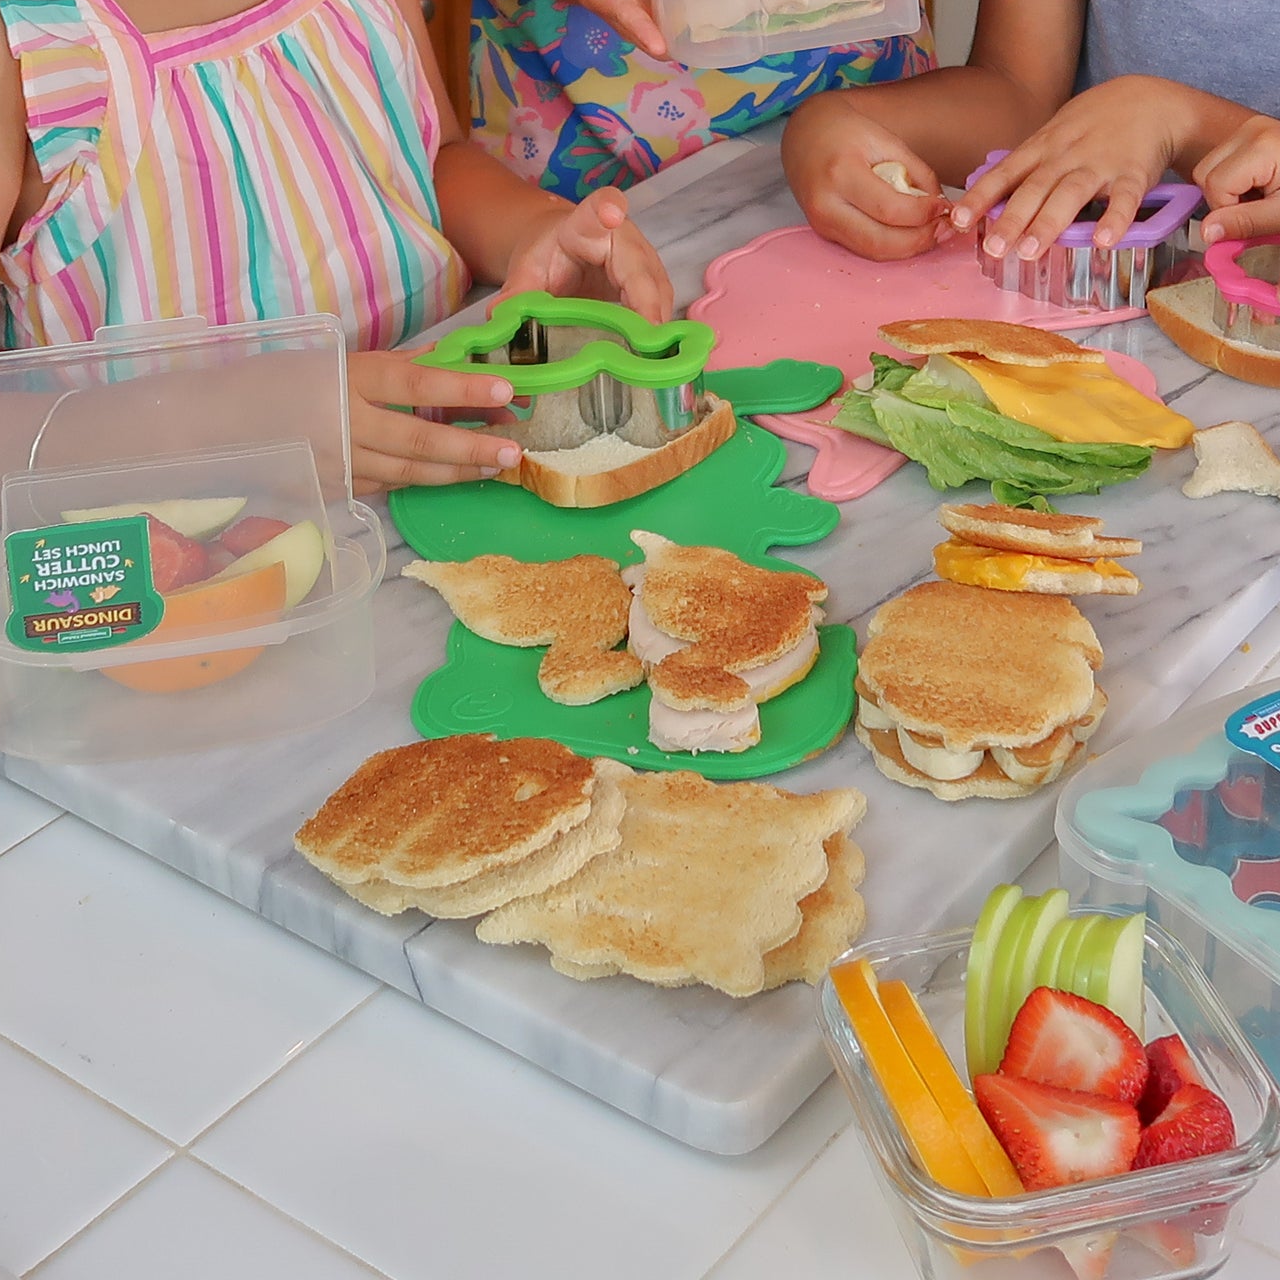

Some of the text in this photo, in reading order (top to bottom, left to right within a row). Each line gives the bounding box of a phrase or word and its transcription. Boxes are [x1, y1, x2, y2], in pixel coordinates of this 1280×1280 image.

[32, 540, 120, 562] LUNCH SET
[35, 554, 120, 577] CUTTER
[34, 570, 125, 592] SANDWICH
[33, 608, 132, 632] DINOSAUR
